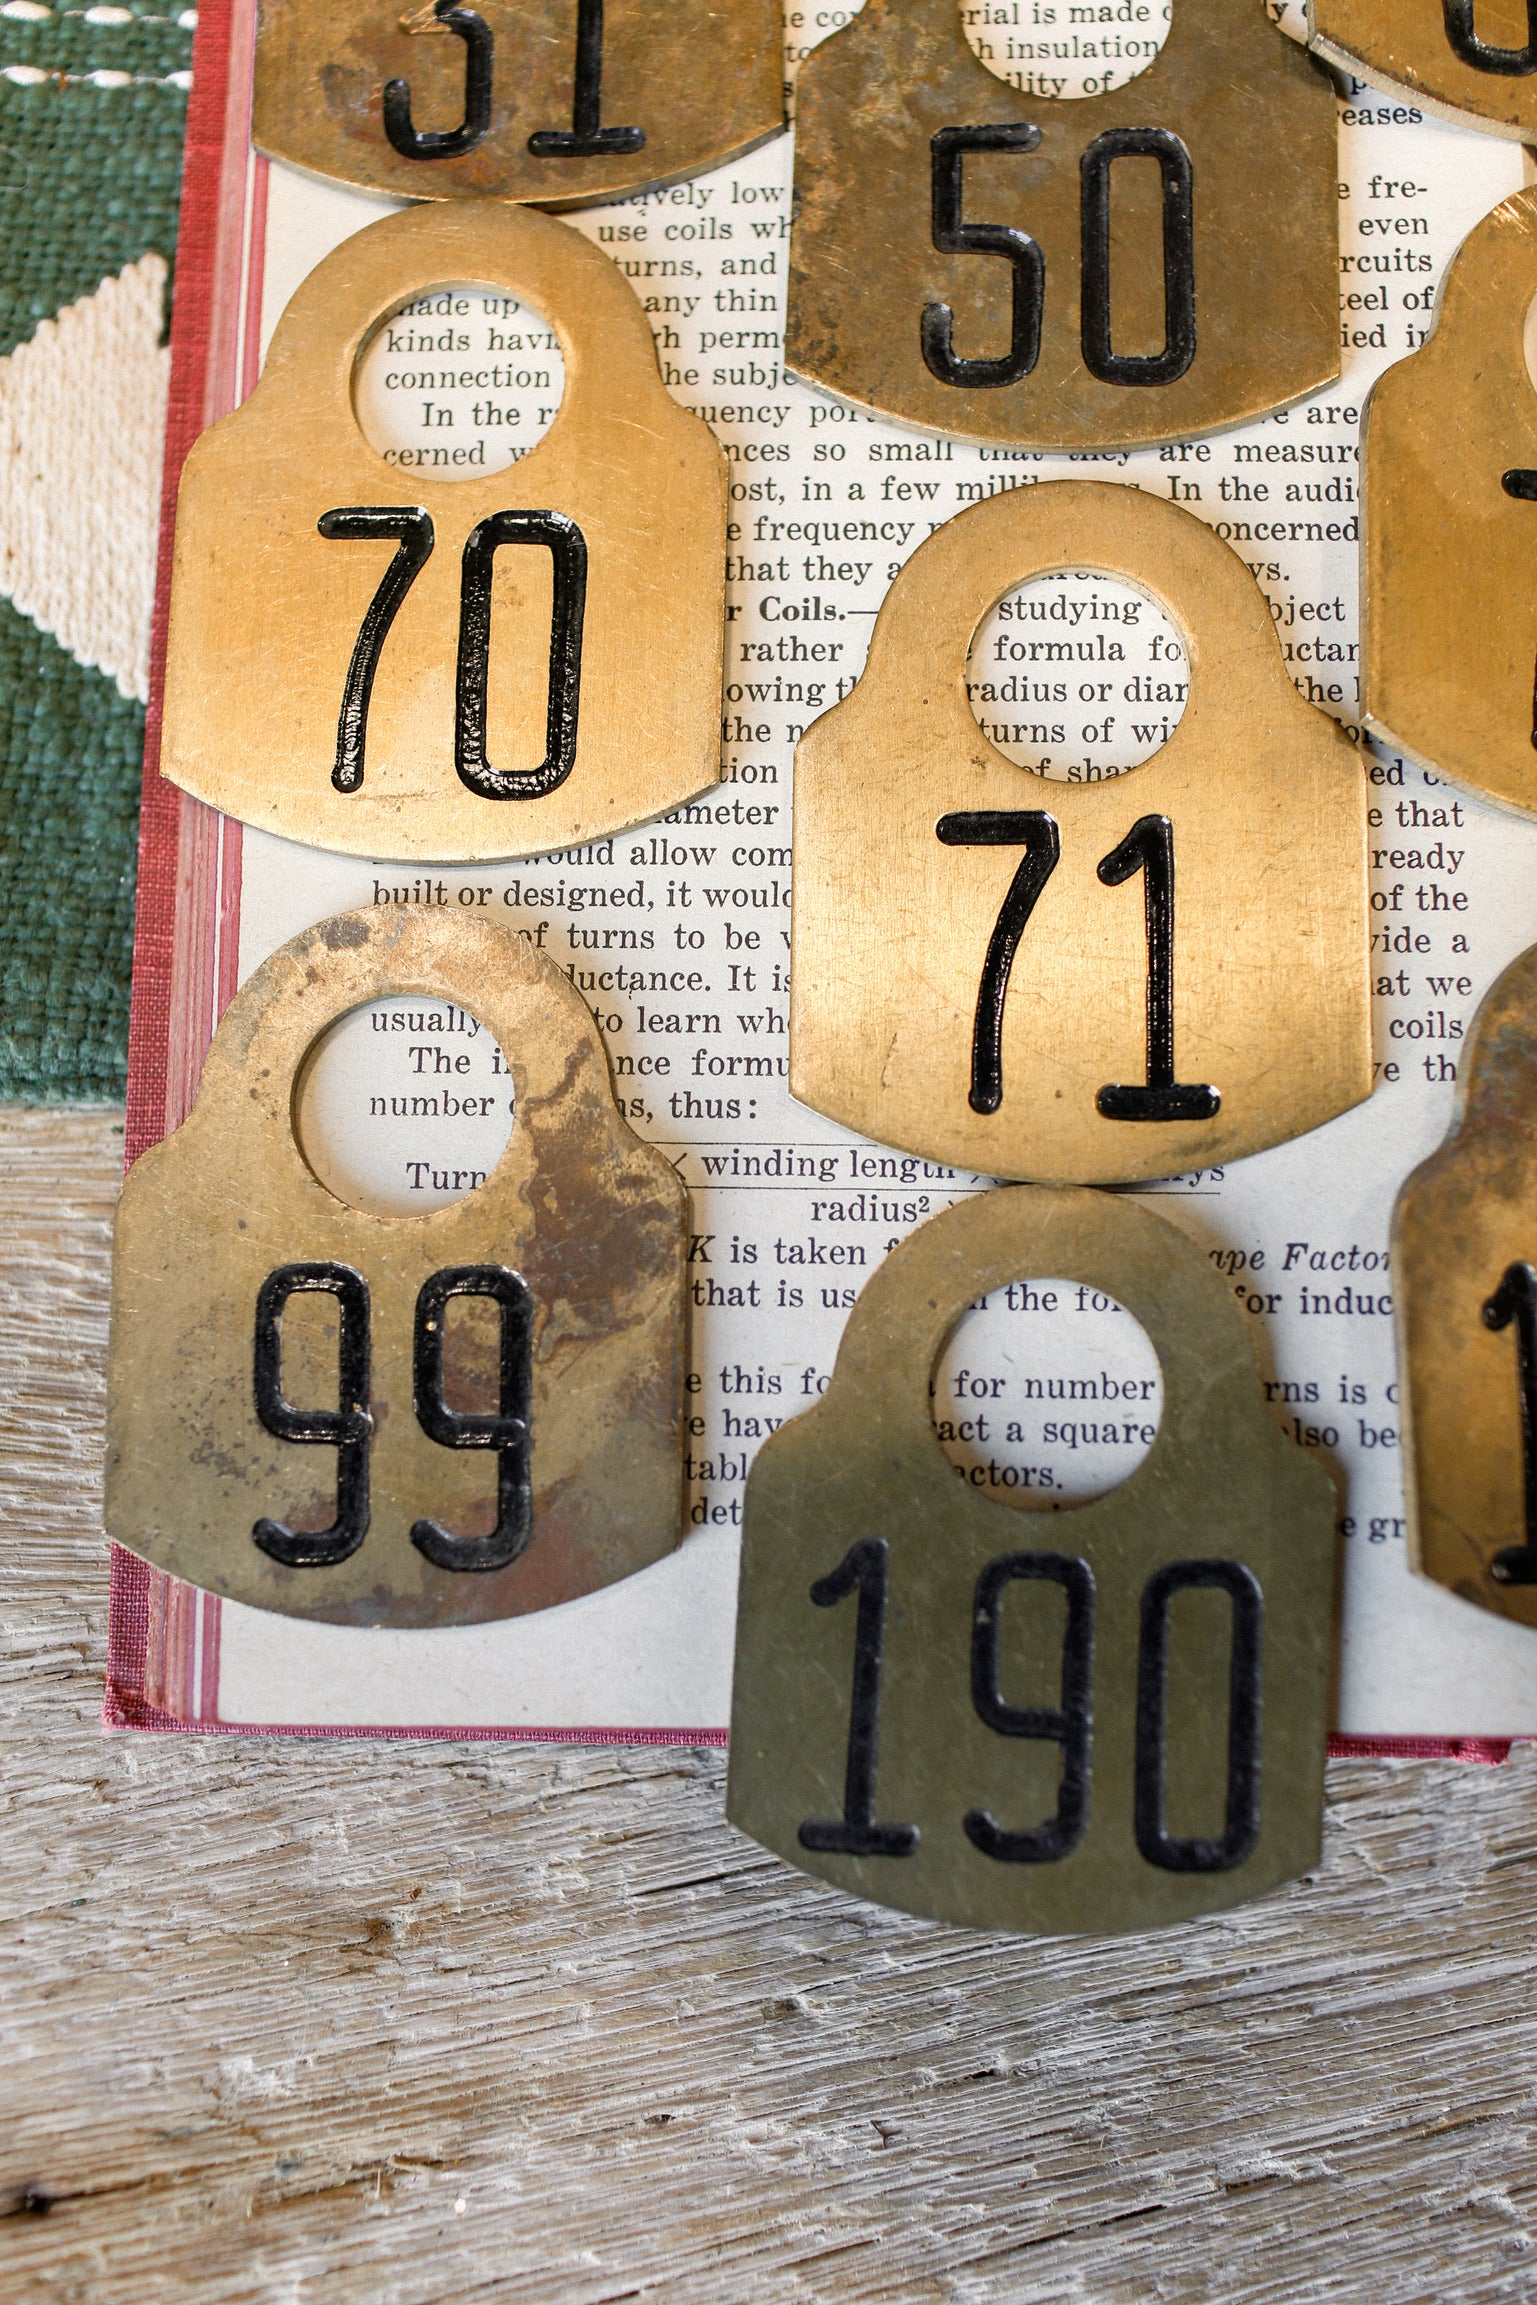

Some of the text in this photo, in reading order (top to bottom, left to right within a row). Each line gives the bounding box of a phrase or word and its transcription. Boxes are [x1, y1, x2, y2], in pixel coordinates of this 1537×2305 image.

[959, 3, 1019, 25] rial
[1032, 2, 1057, 24] is
[1069, 0, 1150, 23] made
[1007, 35, 1159, 59] insulation
[1083, 70, 1114, 94] of
[1337, 107, 1423, 127] eases
[731, 181, 784, 204] low
[1368, 175, 1428, 199] fre-
[598, 225, 648, 242] use
[664, 216, 733, 240] coils
[1358, 217, 1429, 236] even
[720, 251, 777, 275] and
[920, 123, 1197, 388] 50
[1340, 247, 1433, 273] rcuits
[482, 298, 520, 320] up
[643, 288, 778, 318] any thin
[1402, 285, 1435, 311] of
[386, 328, 471, 352] kinds
[699, 331, 789, 353] perm
[385, 363, 551, 390] connection
[662, 362, 700, 386] he
[421, 402, 454, 427] In
[472, 400, 521, 426] the
[1307, 406, 1360, 425] are
[383, 440, 487, 466] cerned
[813, 443, 846, 462] so
[869, 440, 954, 462] small
[1159, 445, 1212, 463] are
[801, 475, 833, 501] in
[847, 481, 867, 501] a
[880, 474, 941, 501] few
[1167, 475, 1203, 501] In
[1218, 476, 1270, 502] the
[1285, 476, 1360, 502] audi
[754, 515, 915, 546] frequency
[726, 555, 791, 582] that
[802, 554, 873, 586] they
[998, 593, 1143, 626] studying
[317, 506, 588, 801] 70
[739, 635, 844, 663] rather
[993, 634, 1127, 662] formula
[966, 675, 1068, 702] radius
[1078, 683, 1114, 703] or
[721, 715, 772, 743] the
[1081, 716, 1116, 744] of
[654, 799, 780, 825] ameter
[1395, 799, 1465, 828] that
[629, 838, 717, 866] allow
[372, 879, 448, 906] built
[457, 886, 493, 907] or
[503, 879, 655, 913] designed,
[665, 880, 693, 908] it
[1369, 883, 1469, 912] of the
[567, 921, 656, 950] turns
[673, 922, 706, 950] to
[723, 922, 761, 950] be
[1451, 933, 1471, 954] a
[727, 964, 757, 992] It
[935, 810, 1221, 1122] 71
[1371, 969, 1473, 997] at we
[371, 1004, 482, 1038] usually
[636, 1005, 722, 1034] learn
[1389, 1010, 1465, 1039] coils
[408, 1046, 471, 1075] The
[369, 1090, 496, 1117] number
[701, 1148, 840, 1182] winding
[687, 1234, 717, 1263] K
[729, 1235, 758, 1264] is
[773, 1236, 868, 1265] taken
[690, 1278, 761, 1307] that
[777, 1279, 804, 1308] is
[1004, 1283, 1059, 1311] the
[719, 1364, 783, 1395] this
[953, 1369, 1007, 1399] for
[1024, 1371, 1157, 1401] number
[1263, 1381, 1320, 1404] rns
[1339, 1374, 1368, 1405] is
[252, 1261, 533, 1572] 99
[932, 1413, 1156, 1449] act a square
[683, 1452, 747, 1482] tabl
[797, 1536, 1264, 1874] 190
